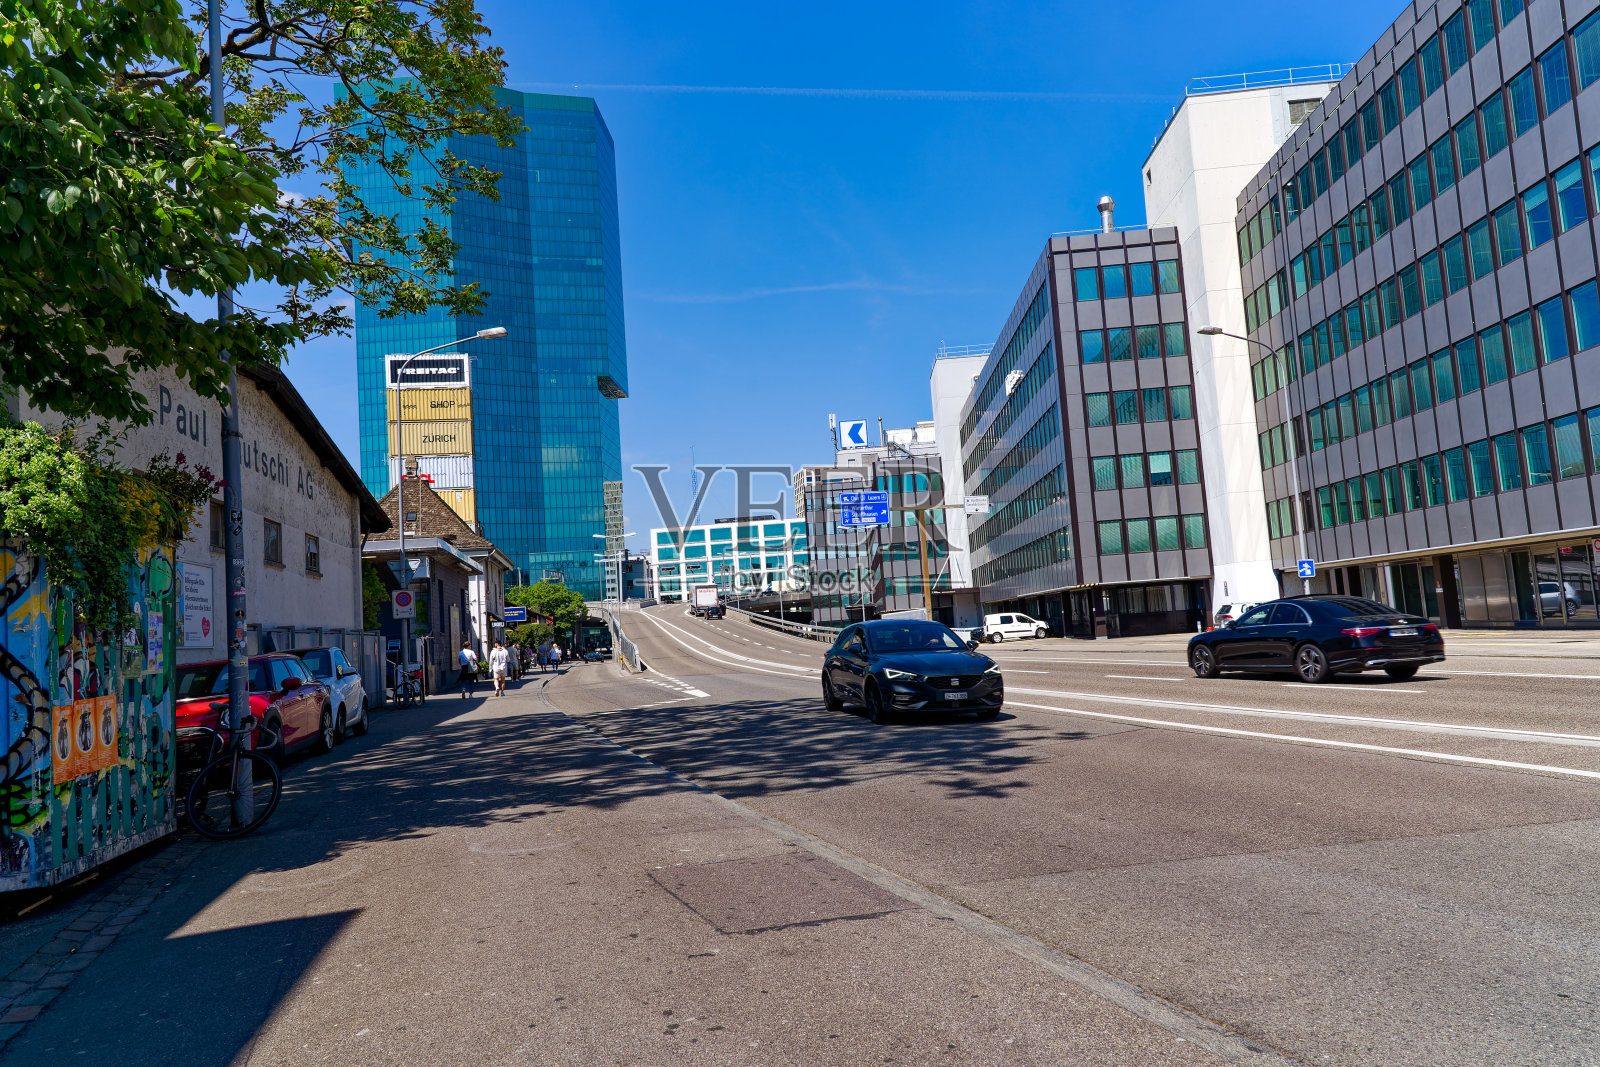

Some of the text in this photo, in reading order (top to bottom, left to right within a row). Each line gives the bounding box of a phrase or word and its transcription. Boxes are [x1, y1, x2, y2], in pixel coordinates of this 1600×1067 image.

[430, 400, 456, 409] SHOP
[159, 384, 315, 501] Paul utschi AG
